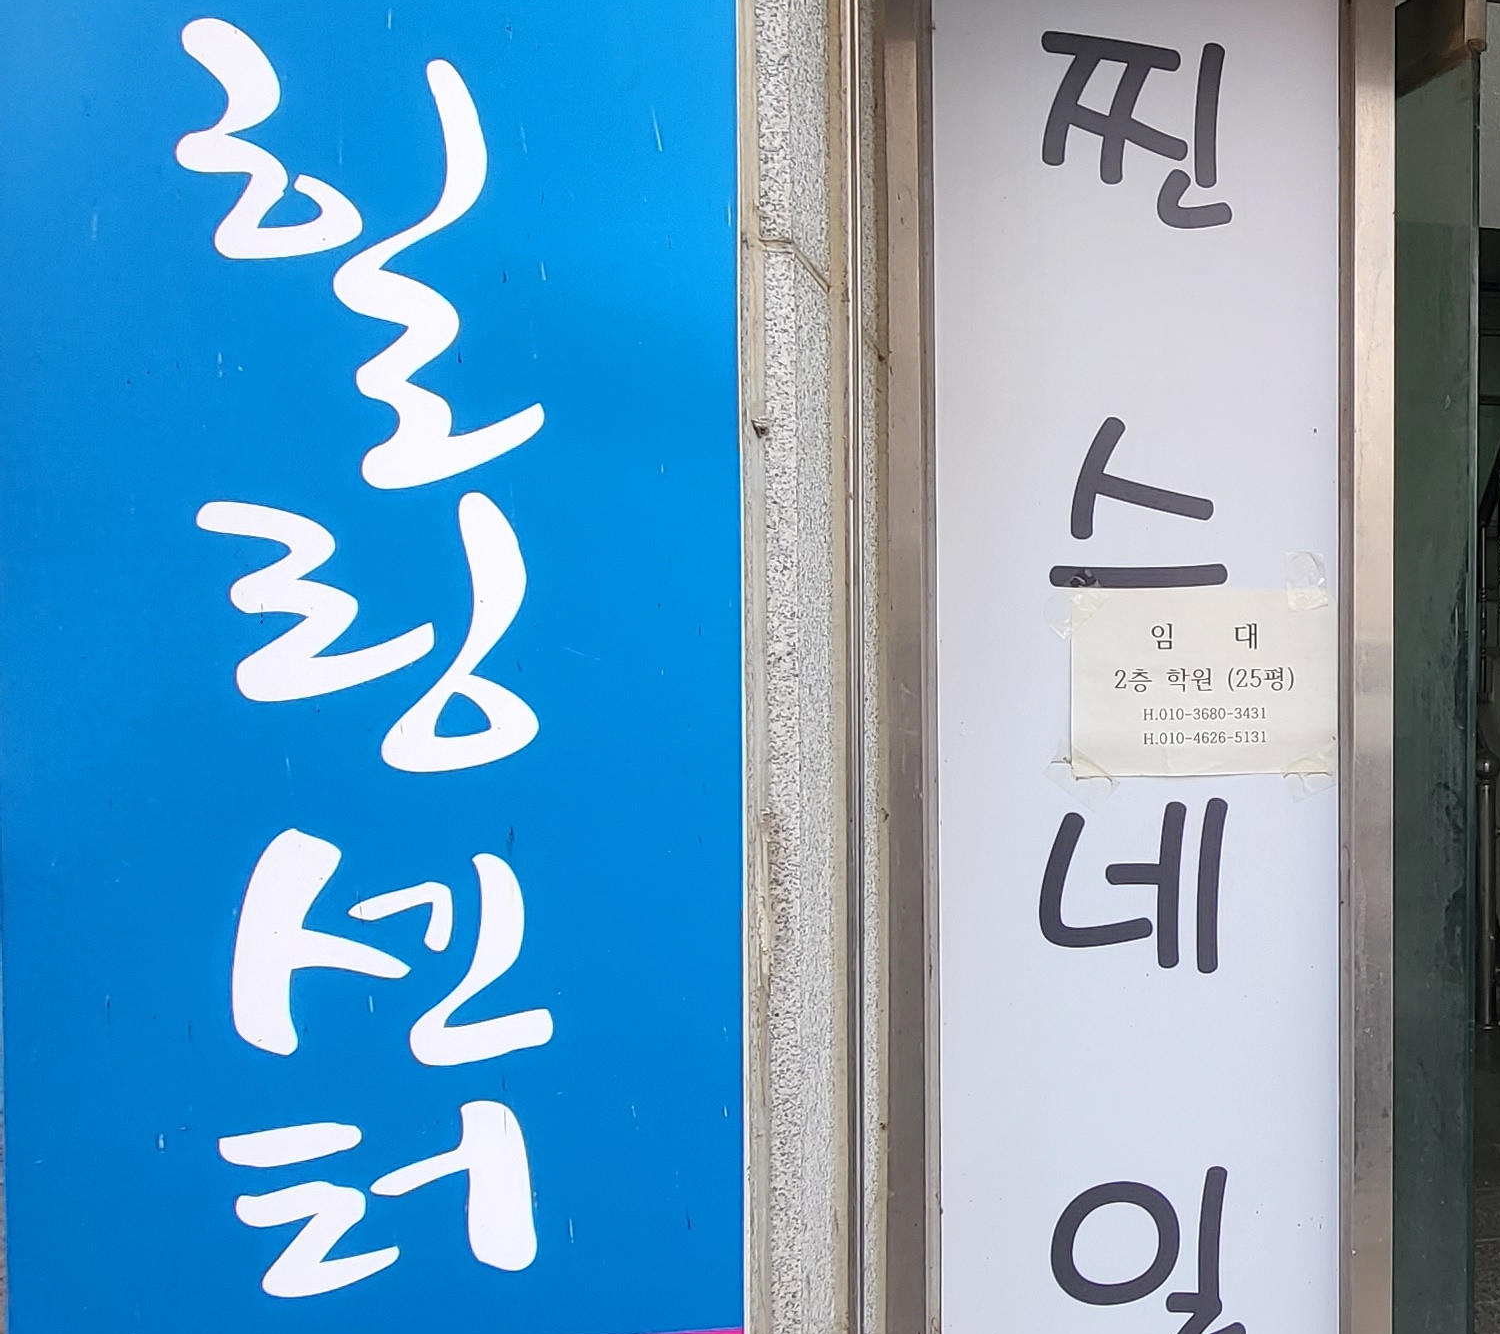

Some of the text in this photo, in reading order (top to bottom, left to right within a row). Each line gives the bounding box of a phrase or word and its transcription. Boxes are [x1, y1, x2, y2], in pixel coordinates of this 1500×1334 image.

[1114, 667, 1295, 693] 2층 학원 (25평)
